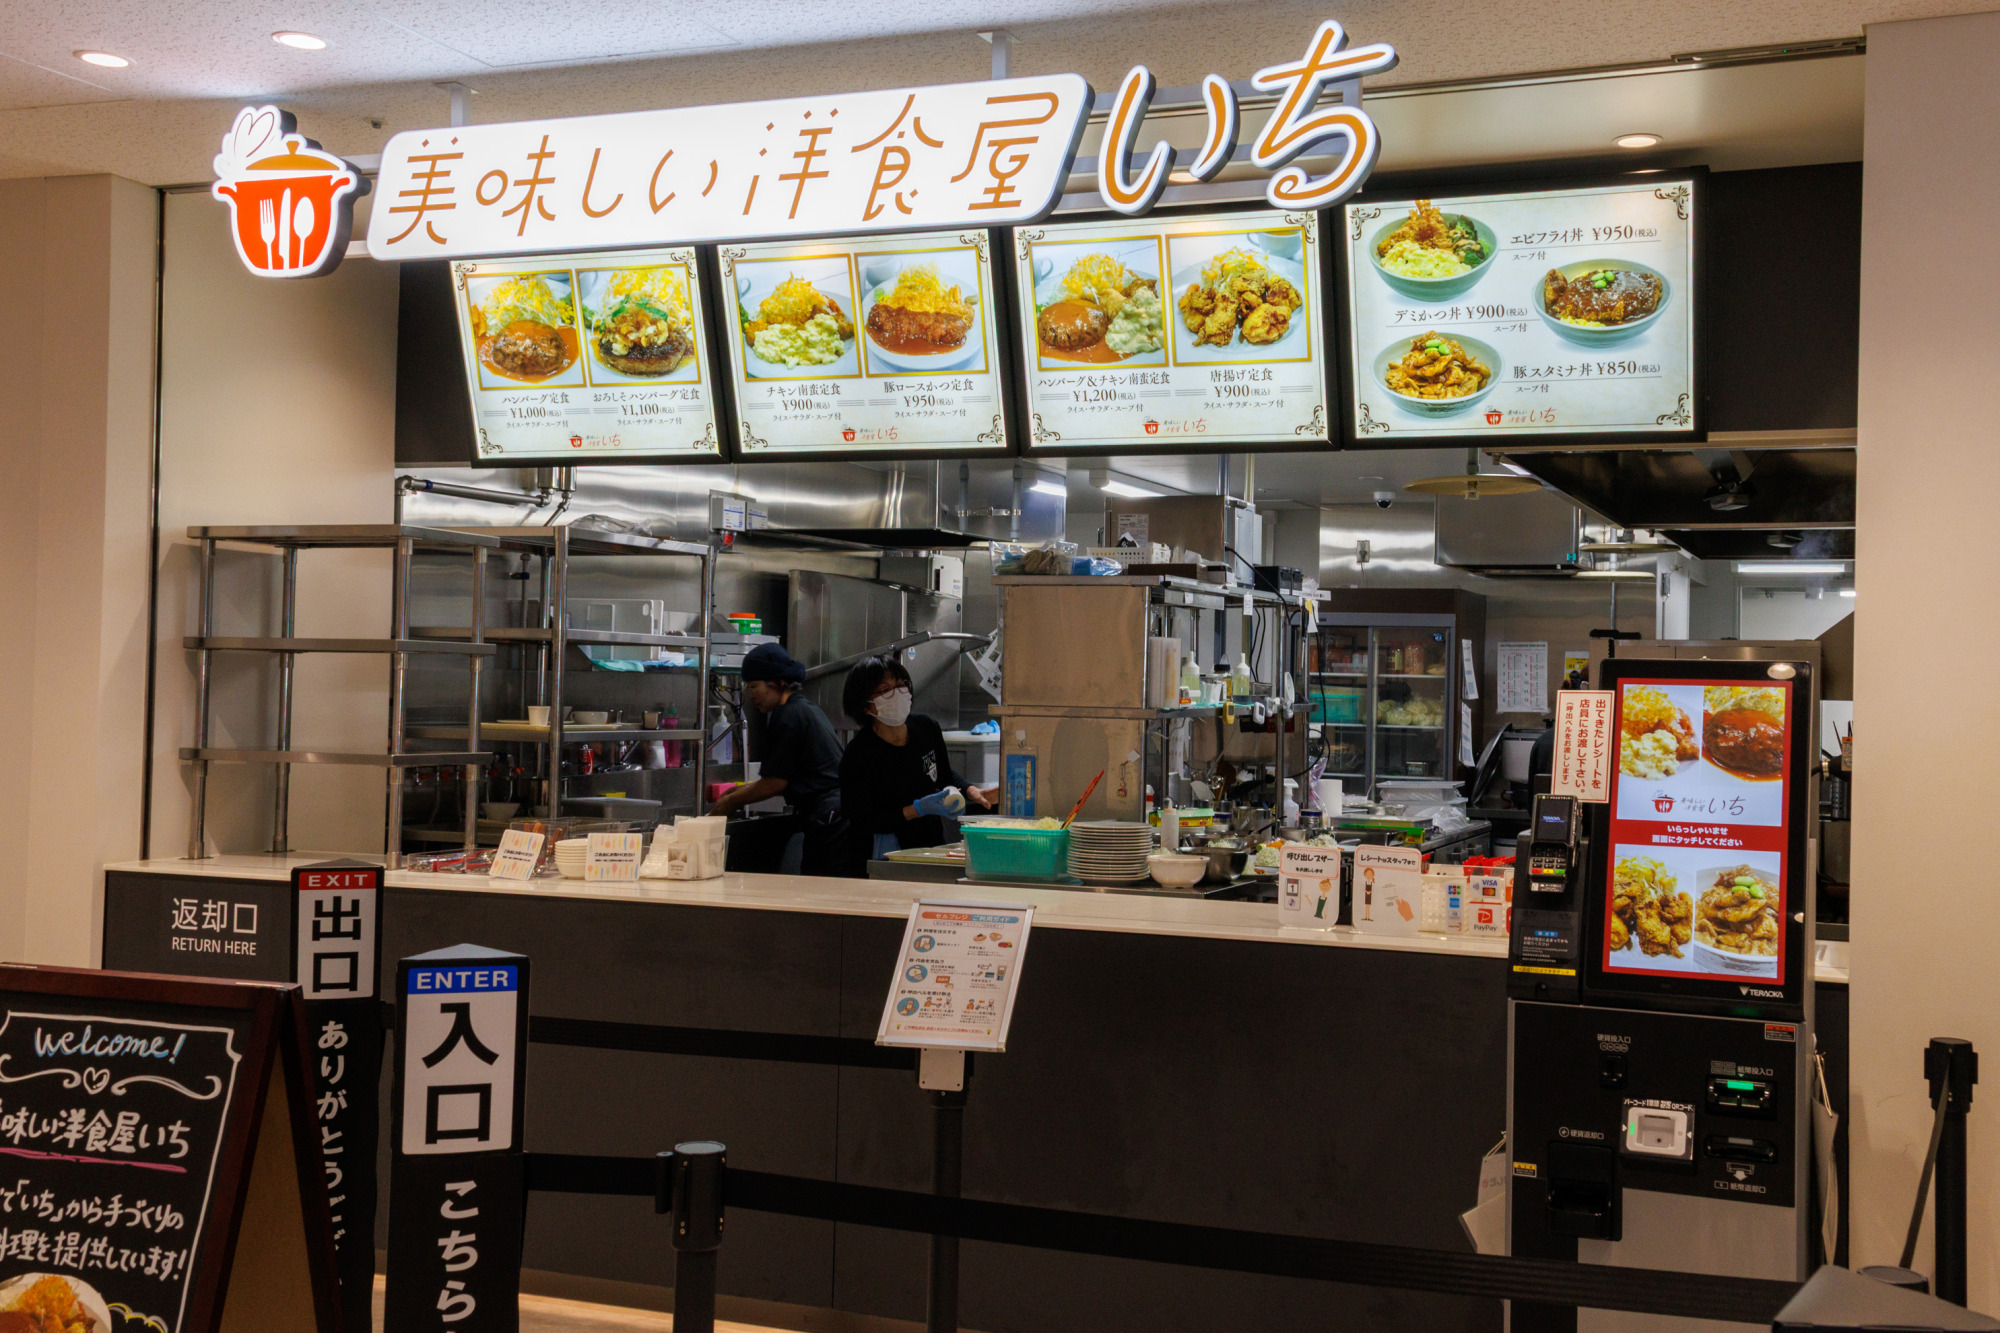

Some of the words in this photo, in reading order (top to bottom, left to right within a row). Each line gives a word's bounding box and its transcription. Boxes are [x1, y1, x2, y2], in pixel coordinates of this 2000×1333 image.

[387, 92, 1059, 246] 美味しい洋食屋
[1099, 20, 1396, 214] いち
[1510, 230, 1584, 245] エビフライ丼
[1592, 225, 1658, 241] ¥950(税込)
[1512, 250, 1547, 261] スープ付
[1394, 307, 1462, 324] デミかつ丼
[1466, 303, 1528, 320] ¥900(税込)
[1494, 322, 1528, 334] スープ付
[1210, 369, 1273, 383] 唐揚げ定食
[1513, 362, 1593, 379] 豚スタミナ丼
[1596, 360, 1661, 376] ¥850(税込)
[766, 382, 842, 397] チキン南蛮定食
[883, 378, 974, 394] 豚ロースかつ定食
[1214, 384, 1271, 399] ¥900(税込)
[1516, 383, 1550, 394] スープ付
[502, 391, 570, 405] ハンバーグ定食
[593, 388, 701, 403] おろしそハンバーグ定食
[903, 393, 954, 408] ¥950(税込)
[781, 397, 831, 411] ¥900(税込)
[1529, 406, 1556, 423] いち
[877, 425, 899, 440] いち
[1183, 418, 1207, 433] いち
[601, 433, 621, 447] いち
[1561, 702, 1574, 785] (呼出ベルをお渡しします)
[1575, 699, 1591, 793] 店員にお渡し下さい。
[1591, 699, 1606, 789] 出てきたレシートを
[1708, 795, 1746, 816] いち
[1667, 825, 1728, 835] いらっしゃいませ
[1652, 834, 1743, 847] 画面にタッチしてください
[1286, 852, 1334, 863] 呼び出しブザー
[1360, 854, 1416, 866] レシートはスタッフまで
[308, 873, 369, 889] EXIT
[1482, 879, 1498, 887] VISA
[171, 898, 258, 934] 返却口
[1473, 923, 1498, 932] PayPay
[171, 936, 221, 954] RETURN
[224, 938, 257, 956] HERE
[312, 896, 362, 993] 出口
[416, 969, 510, 990] ENTER
[1749, 987, 1784, 999] TERAOKA
[421, 1002, 500, 1145] 入口
[0, 1099, 191, 1159] 味しい洋食屋いち
[0, 1179, 185, 1233] て「いち」から手づくりの
[437, 1180, 480, 1333] こちら
